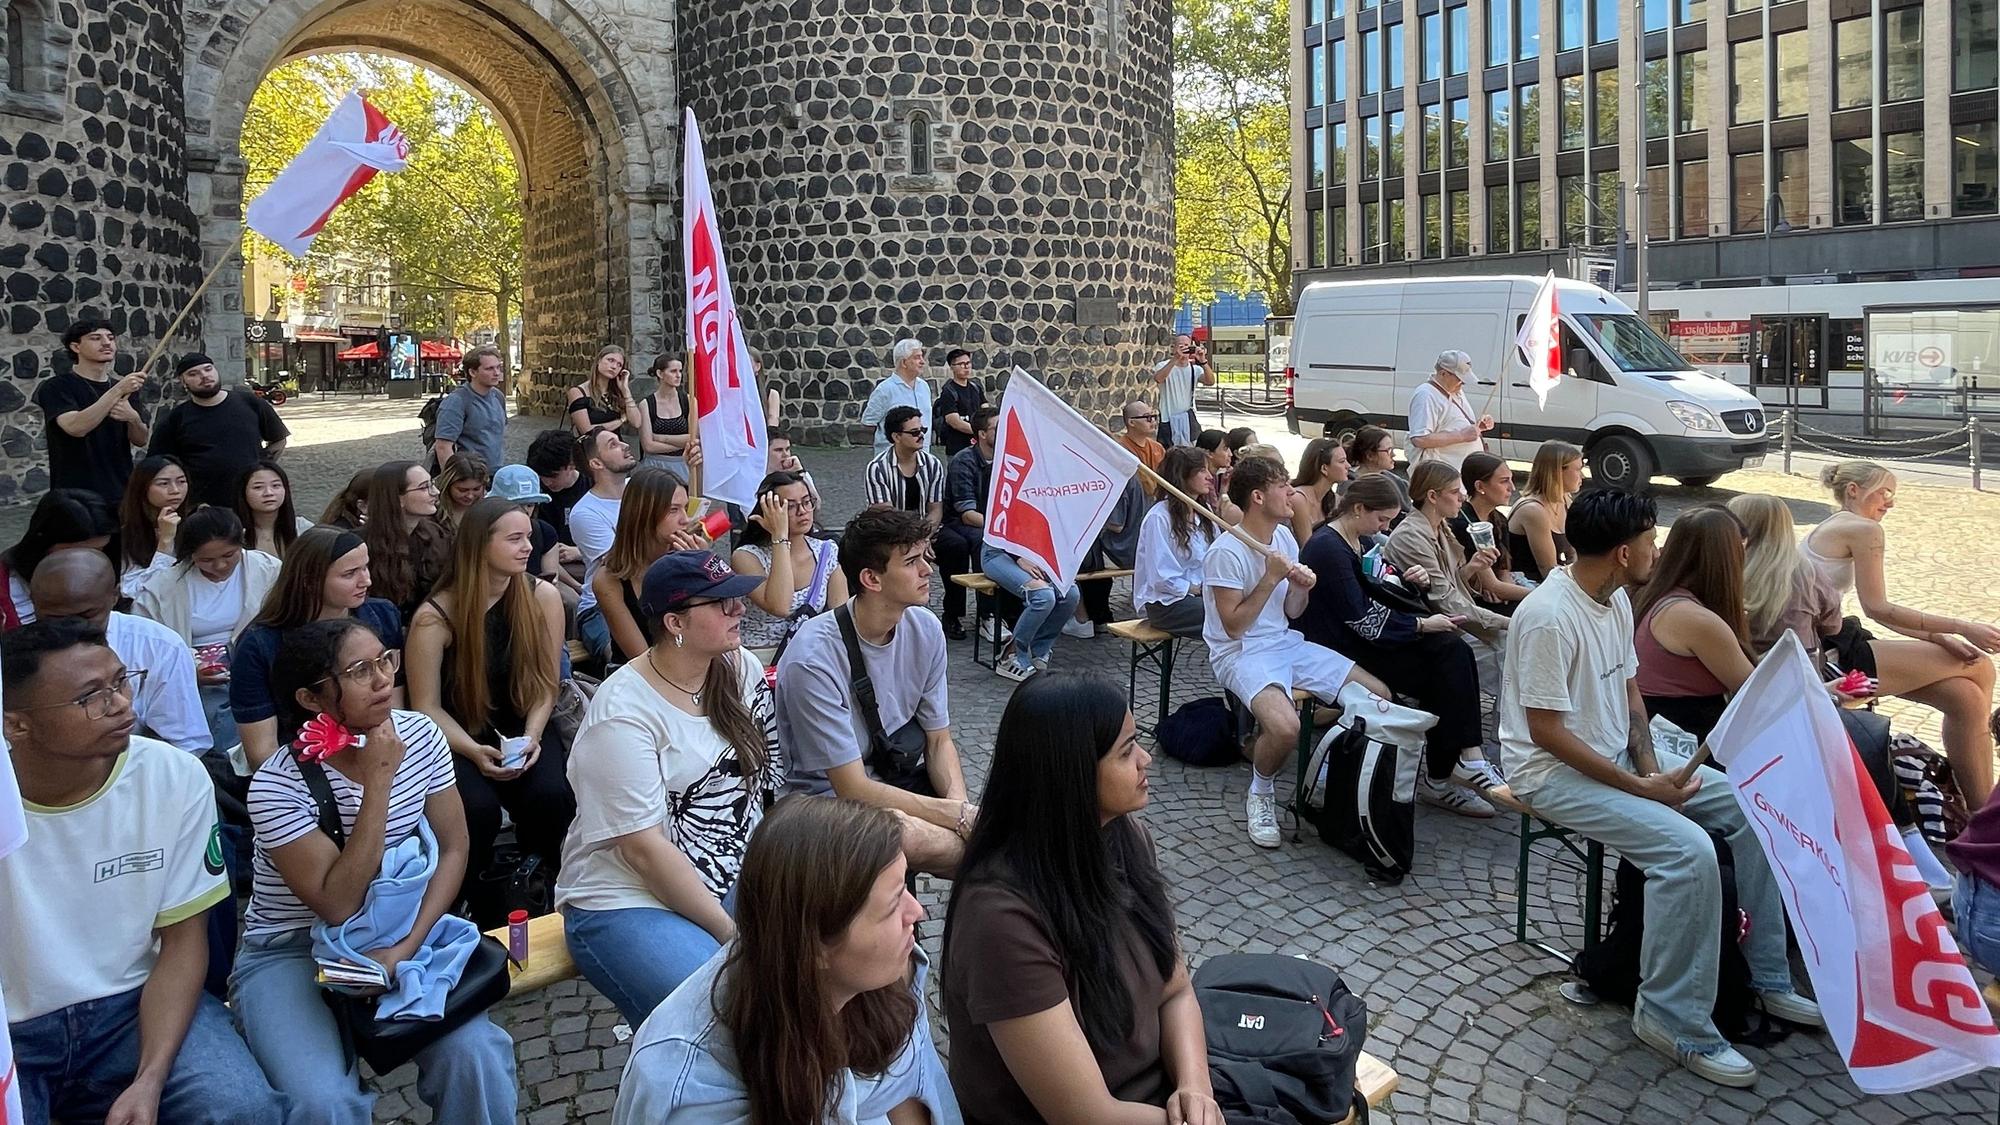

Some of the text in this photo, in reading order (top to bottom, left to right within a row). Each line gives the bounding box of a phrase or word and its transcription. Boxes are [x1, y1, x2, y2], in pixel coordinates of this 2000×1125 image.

[693, 265, 718, 355] NG
[1847, 335, 1862, 343] Die
[1883, 350, 1917, 363] KVB
[101, 864, 114, 878] H
[1238, 1013, 1265, 1030] CAT
